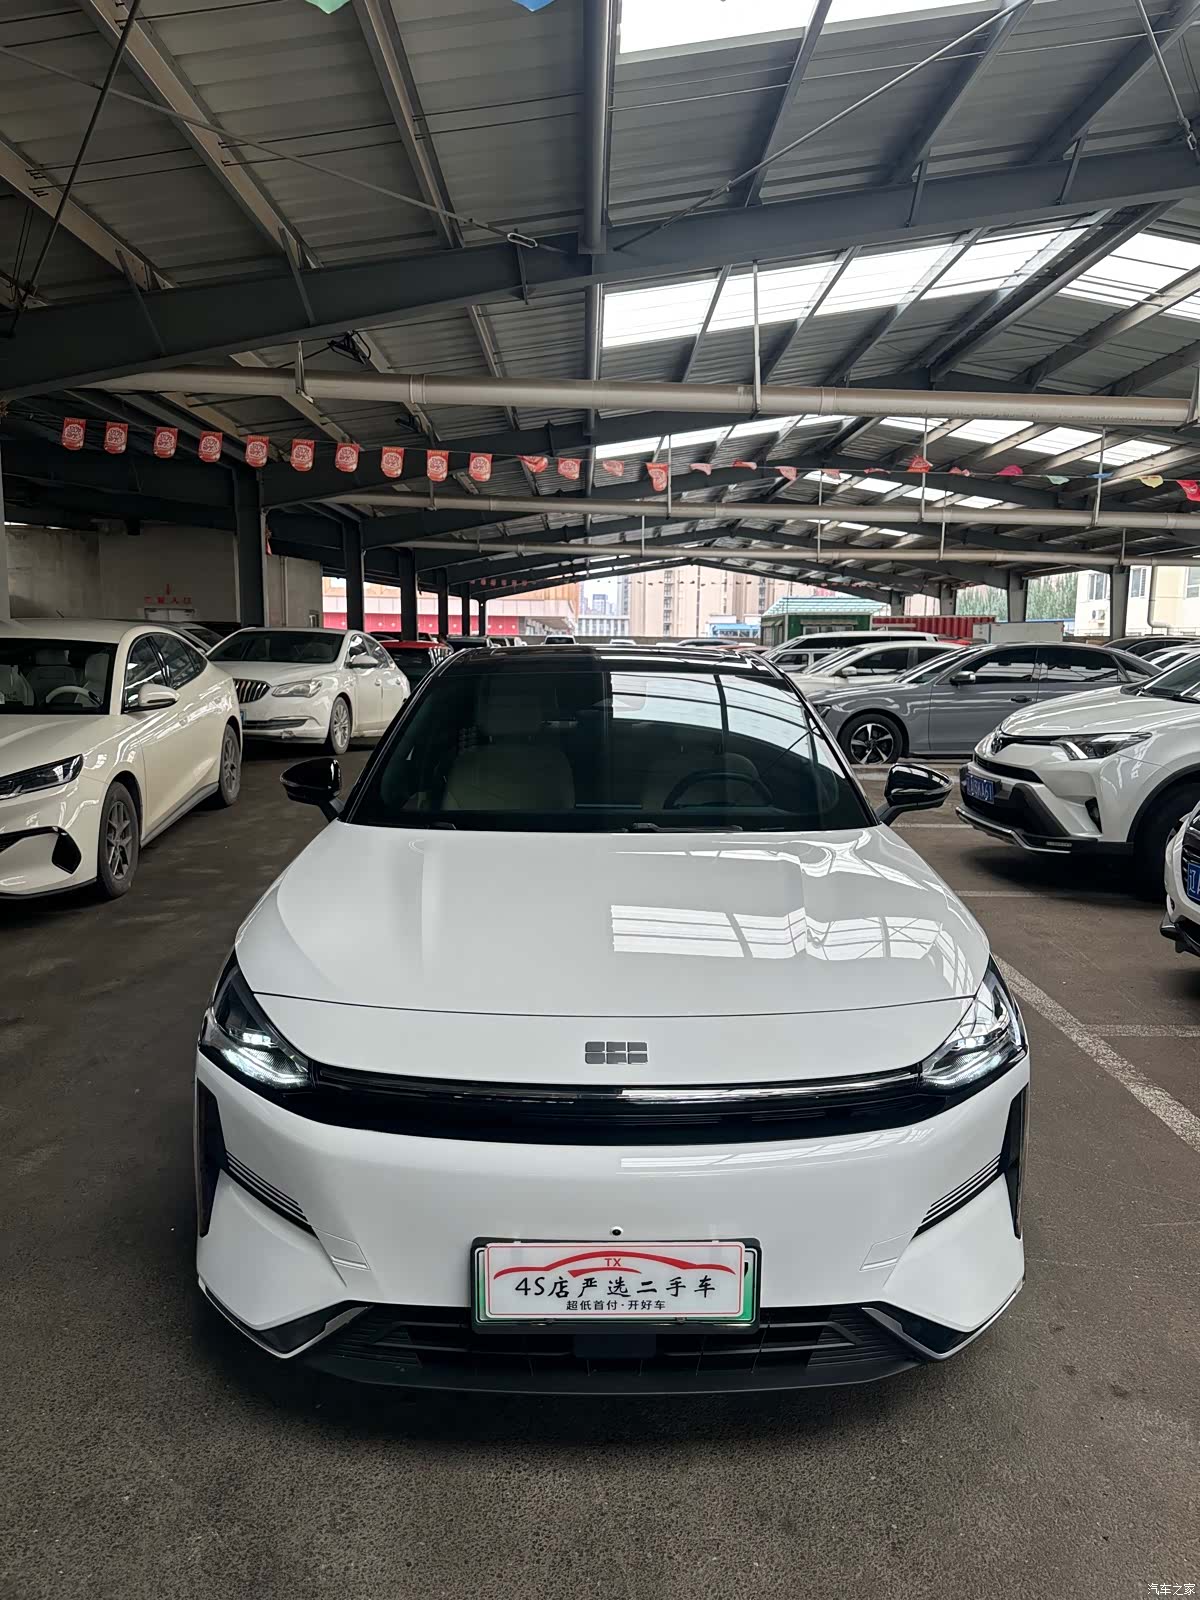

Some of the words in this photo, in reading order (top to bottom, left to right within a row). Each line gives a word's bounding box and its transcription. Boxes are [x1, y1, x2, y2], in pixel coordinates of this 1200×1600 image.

[604, 1258, 621, 1266] TX
[515, 1275, 716, 1298] 4S店严选二手车
[566, 1300, 666, 1311] 超低首付·开好车
